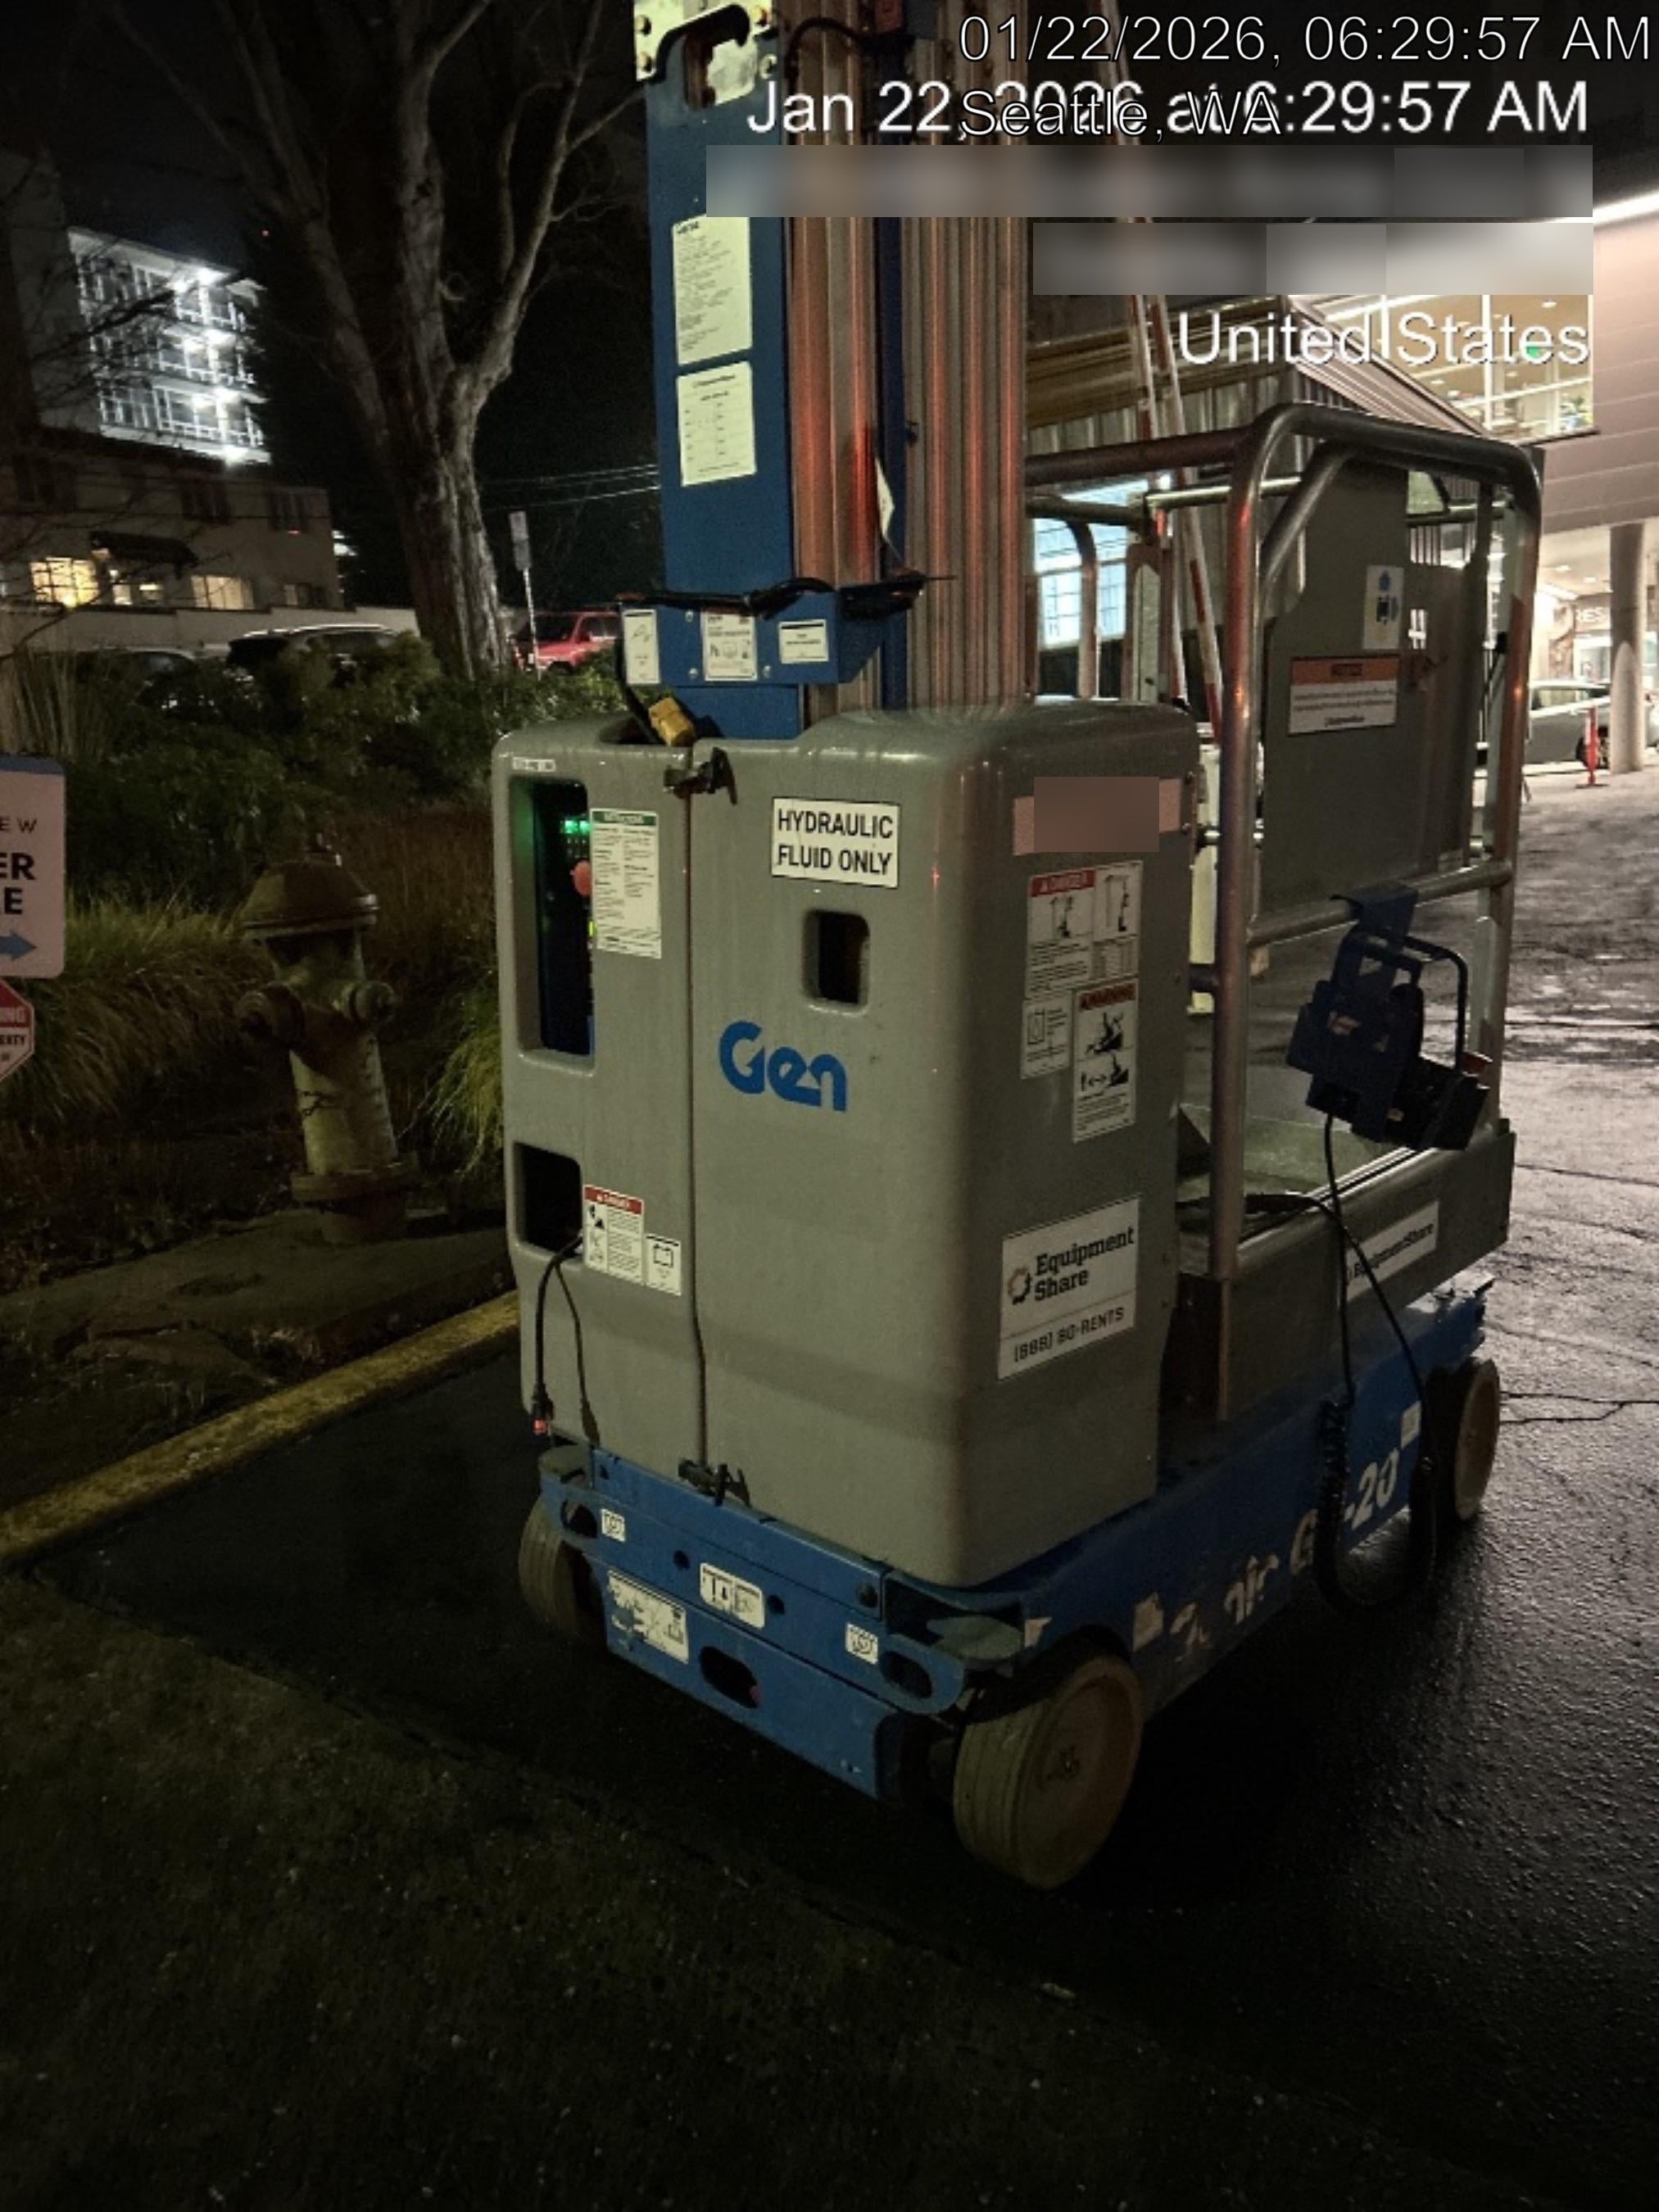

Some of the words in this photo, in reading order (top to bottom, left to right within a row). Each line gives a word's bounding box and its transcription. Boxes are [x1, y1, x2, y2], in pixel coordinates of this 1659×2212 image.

[777, 807, 894, 839] HYDRAULIC
[777, 844, 832, 869] FLUID
[838, 849, 893, 876] ONLY
[0, 886, 23, 915] E
[719, 1019, 847, 1113] Gen
[1035, 1226, 1135, 1276] Equipment
[1033, 1269, 1090, 1302] Share
[1013, 1331, 1054, 1362] (888)
